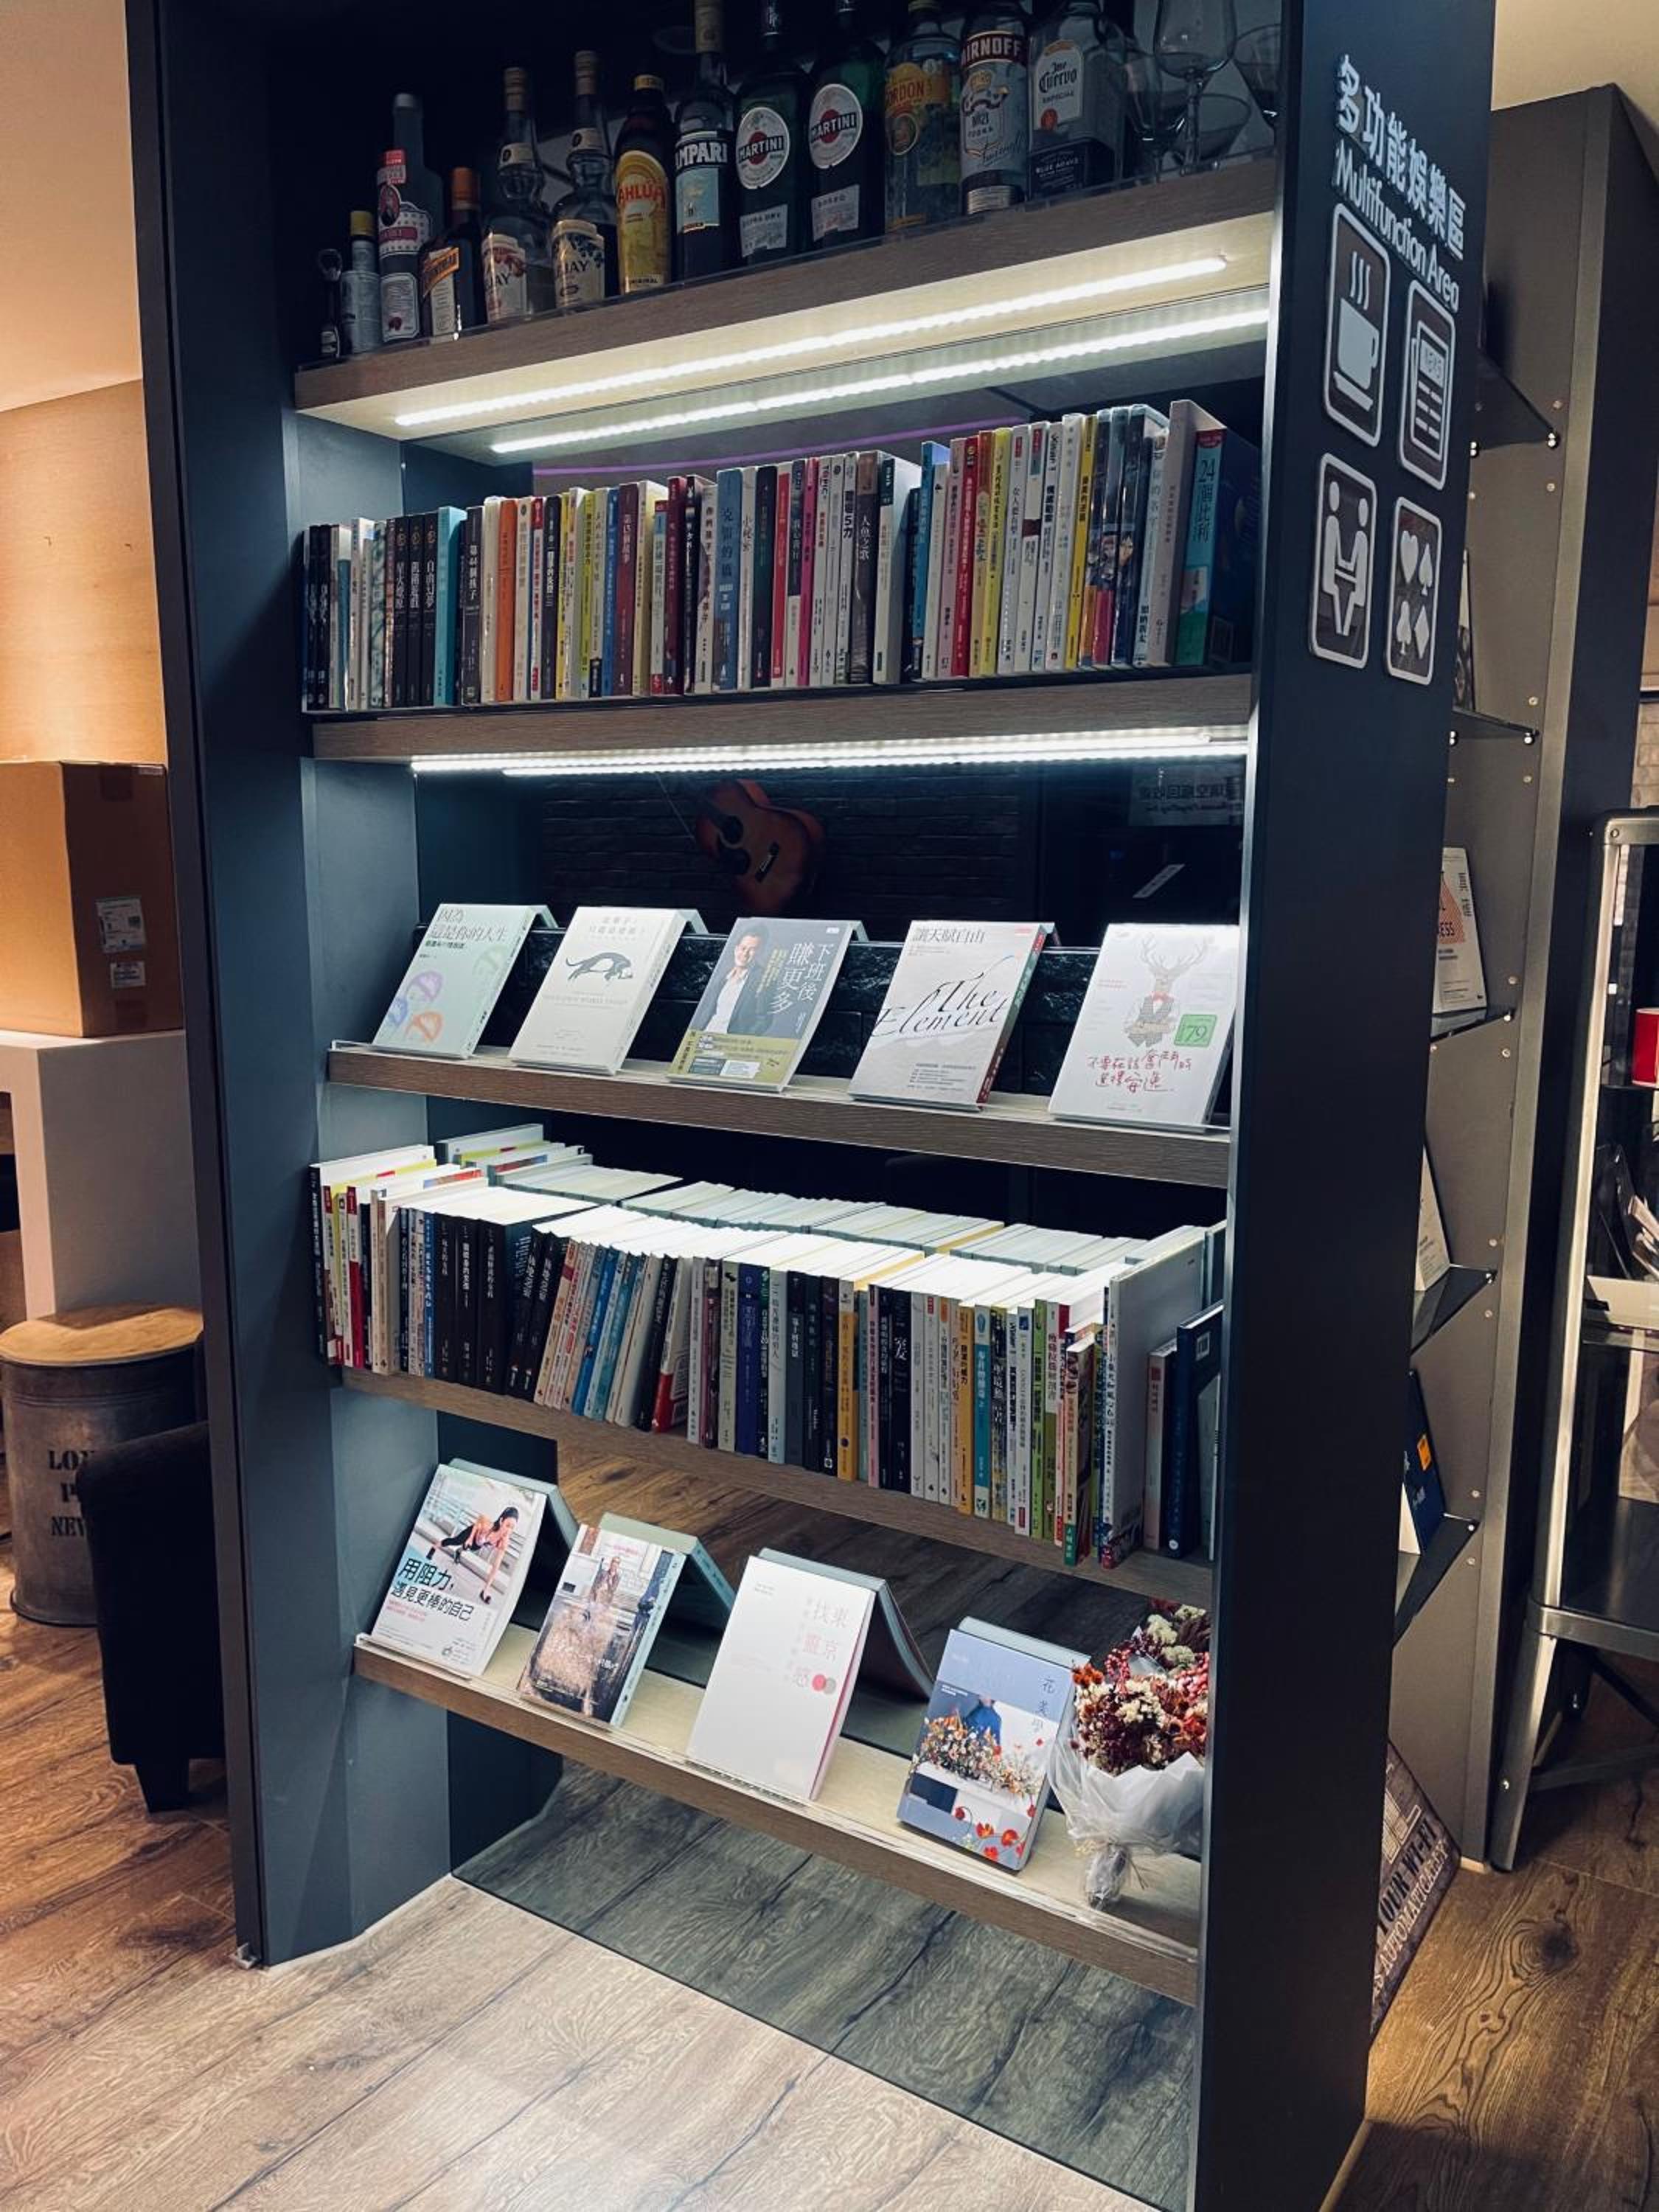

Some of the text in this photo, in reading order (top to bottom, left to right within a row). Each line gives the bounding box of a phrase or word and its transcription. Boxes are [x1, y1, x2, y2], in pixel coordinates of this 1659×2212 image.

[739, 136, 784, 163] MARTINI
[810, 114, 857, 142] MARTINI
[1338, 54, 1465, 260] 多功能娛樂區
[1335, 139, 1458, 313] Multifunction Area
[911, 927, 986, 945] 讓天賦自由
[767, 942, 815, 1015] 賺更多
[796, 942, 835, 1004] 下班後
[938, 964, 1004, 1013] The
[870, 990, 1009, 1037] Element
[389, 1580, 475, 1622] 遇見更棒的自己
